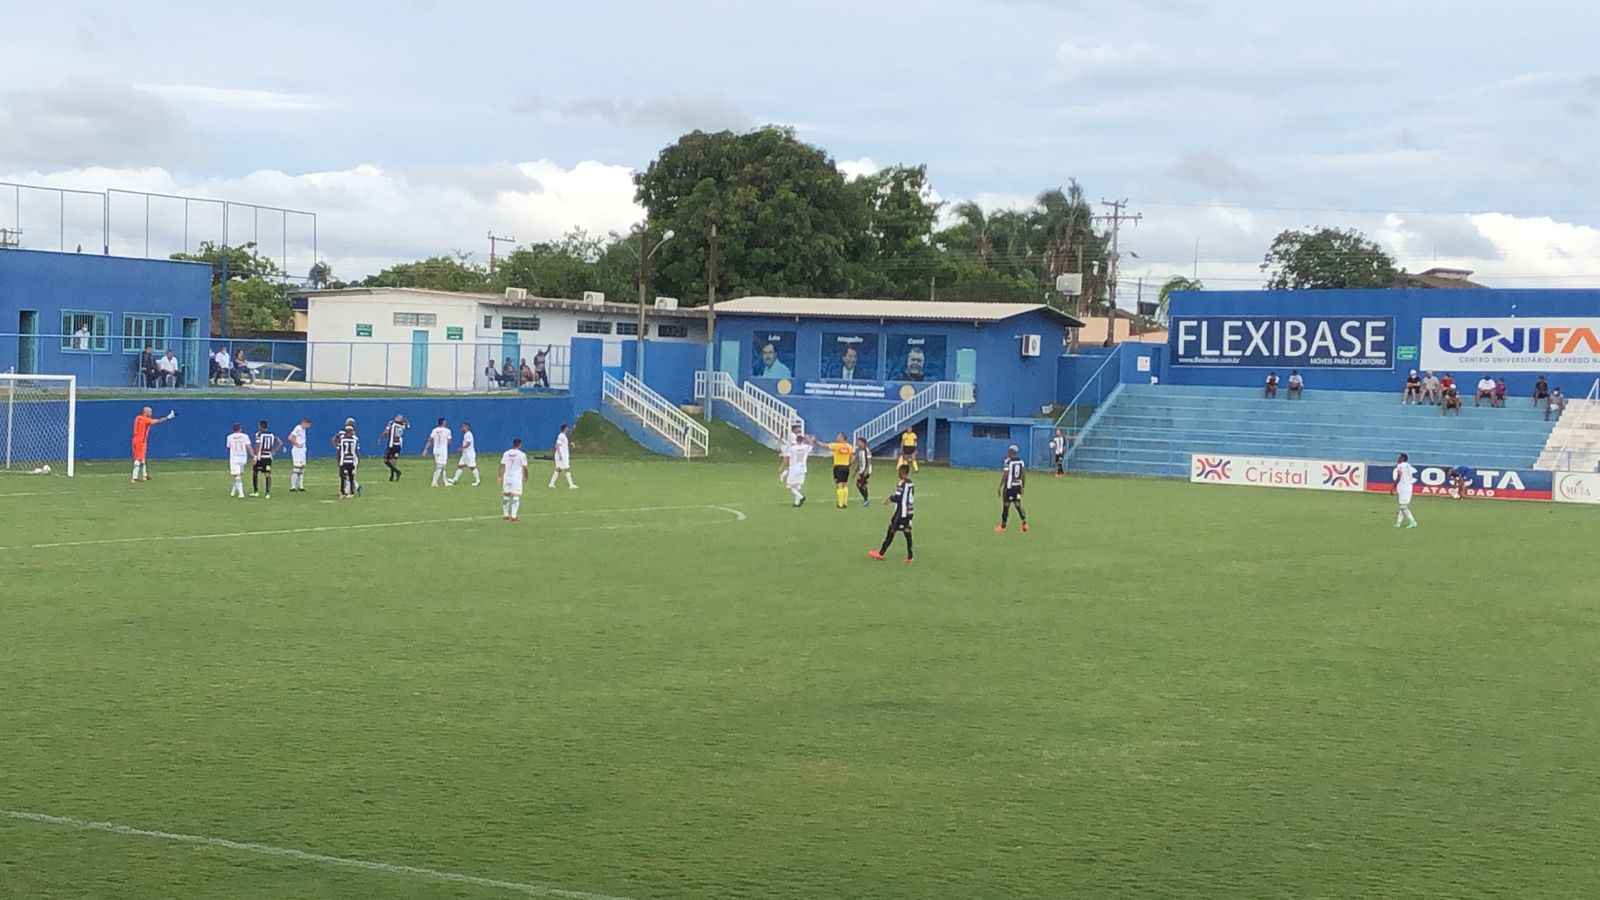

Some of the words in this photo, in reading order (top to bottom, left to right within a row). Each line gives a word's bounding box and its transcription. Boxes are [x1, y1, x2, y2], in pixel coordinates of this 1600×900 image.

[1178, 320, 1386, 357] FLEXIBASE
[1492, 355, 1551, 363] UNIVERSITÁRIO
[1245, 467, 1308, 485] Cristal
